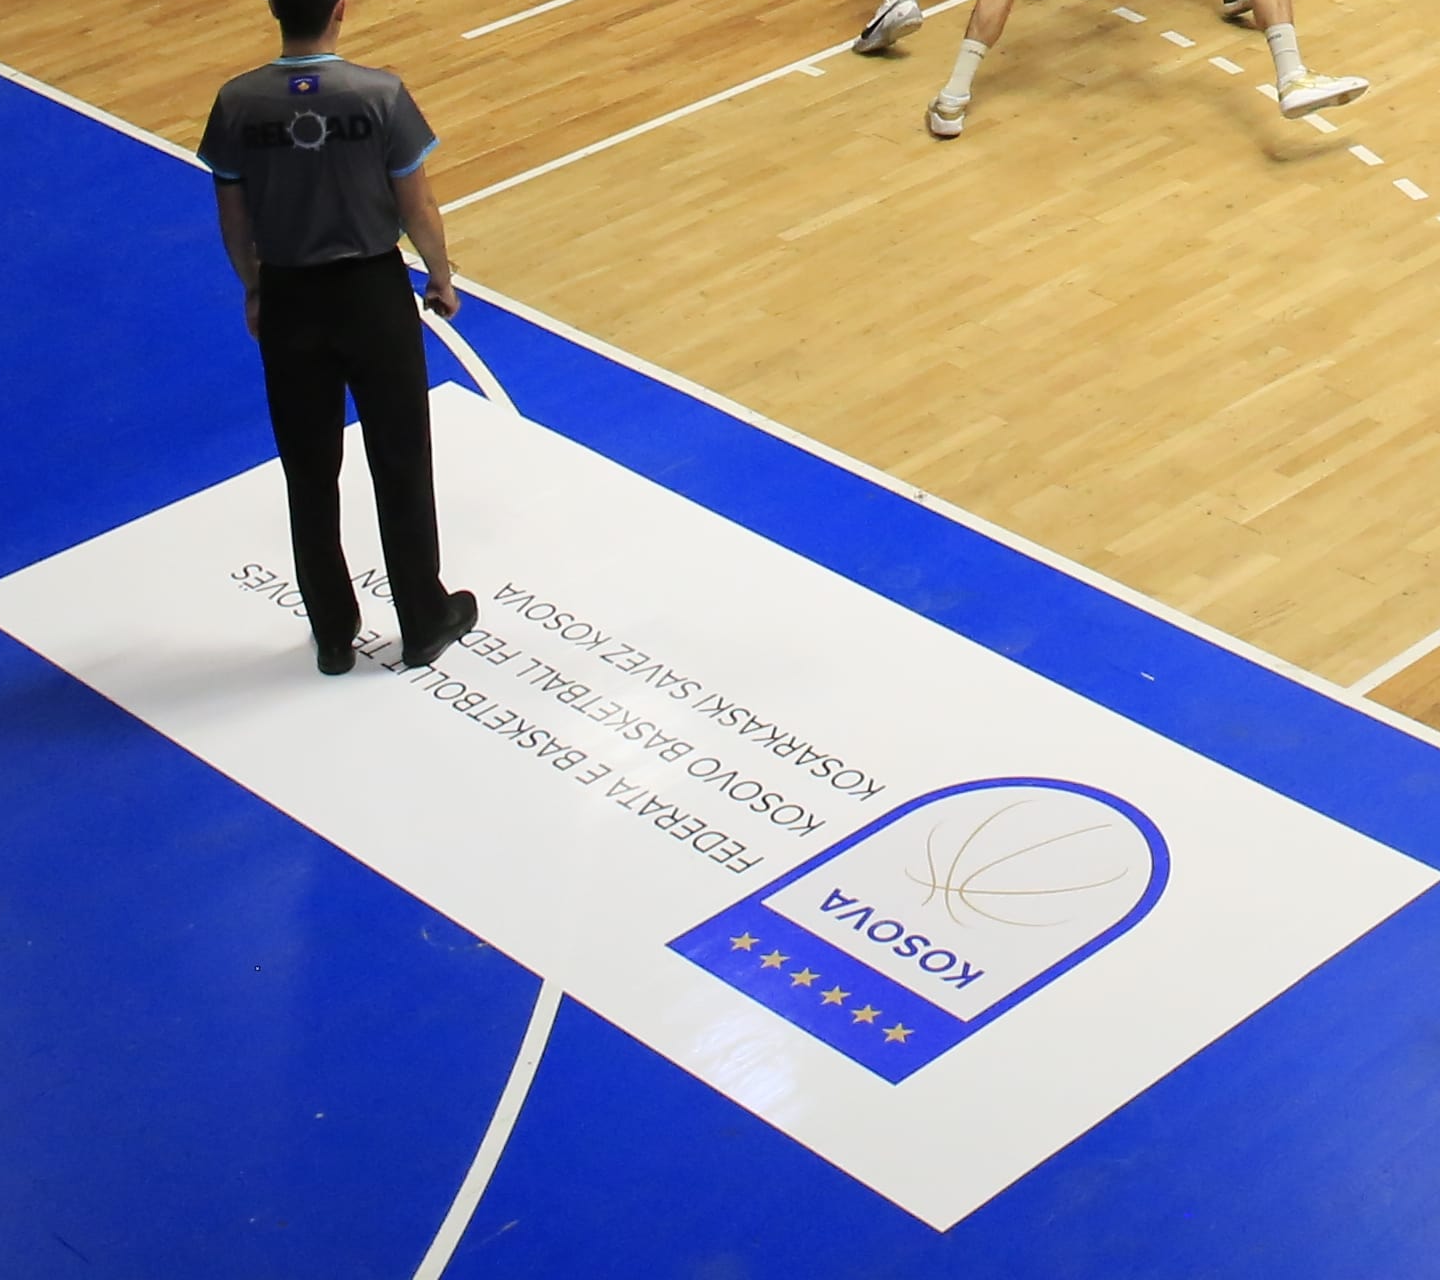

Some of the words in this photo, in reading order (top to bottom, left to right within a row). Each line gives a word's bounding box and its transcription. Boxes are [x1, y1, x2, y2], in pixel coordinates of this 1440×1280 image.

[492, 581, 612, 645] KOSOVA
[518, 662, 686, 761] BASKETBALL
[603, 639, 693, 703] SAVEZ
[579, 761, 609, 786] E
[694, 693, 887, 802] KOSARKASKI
[603, 772, 766, 875] FEDERATA
[688, 755, 826, 837] KOSOVO
[820, 887, 985, 989] KOSOVA
